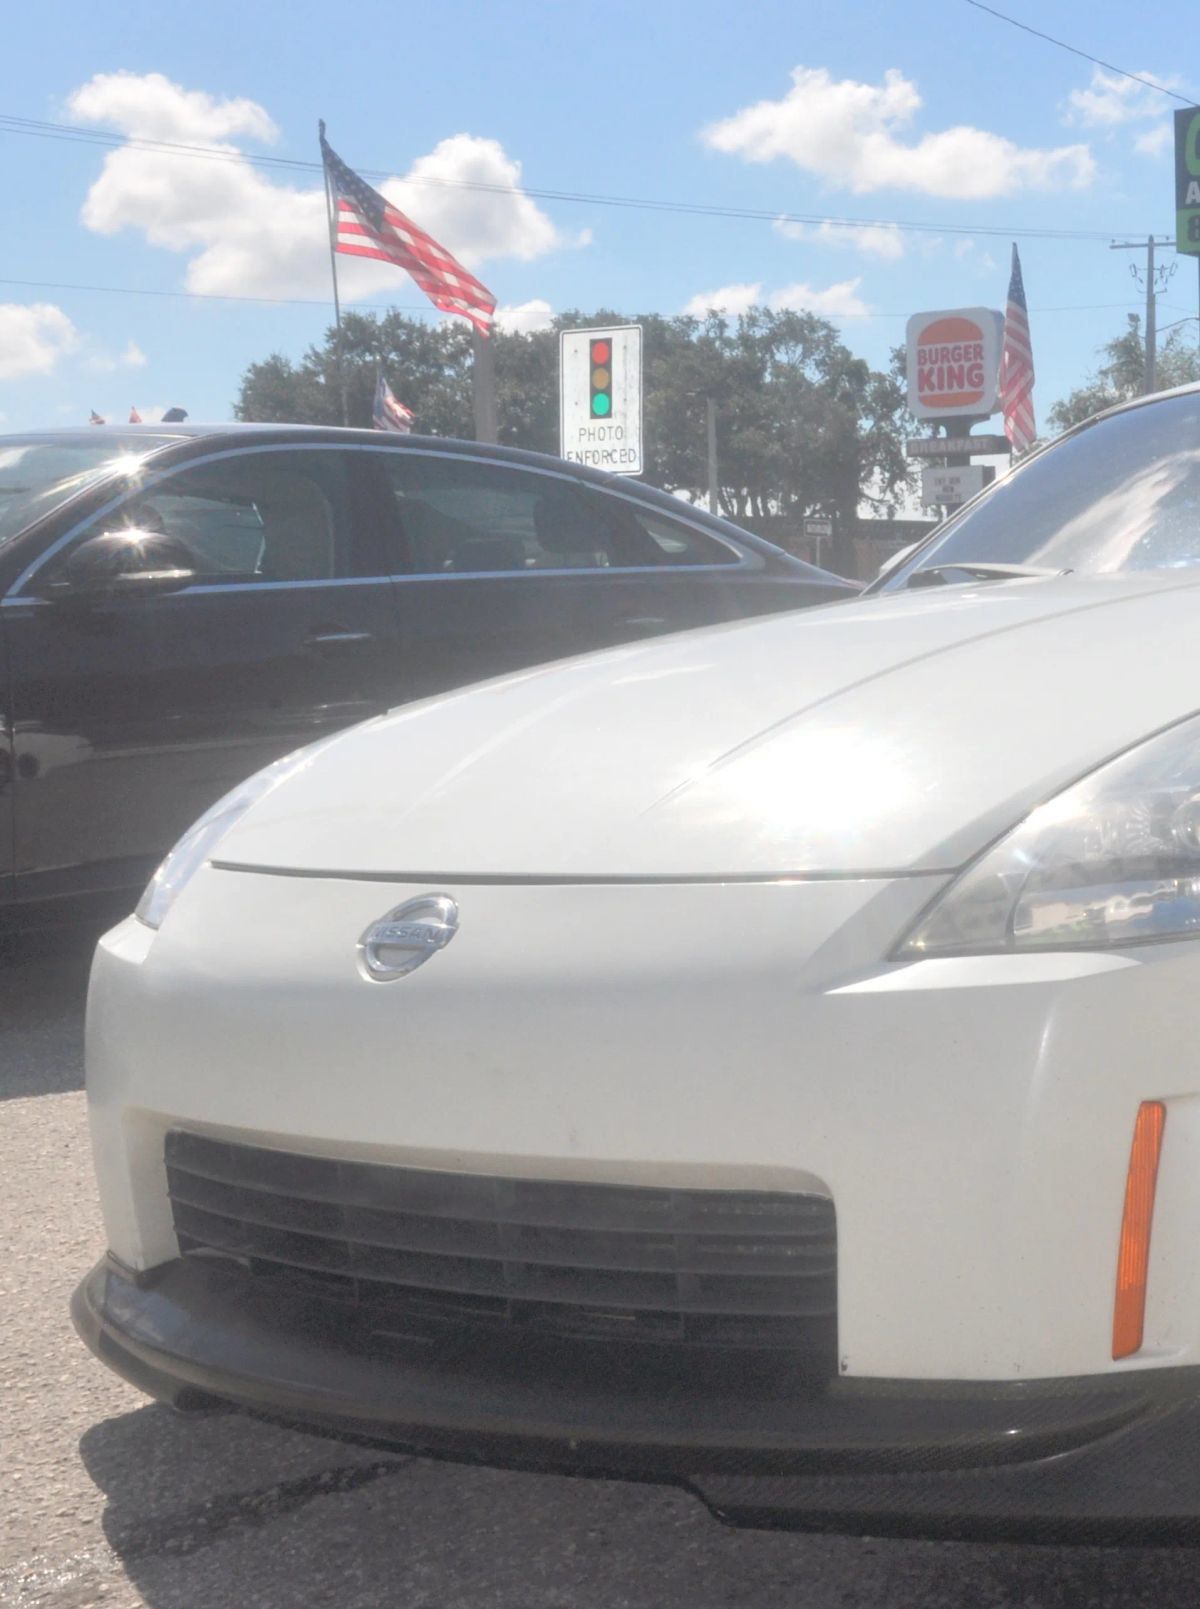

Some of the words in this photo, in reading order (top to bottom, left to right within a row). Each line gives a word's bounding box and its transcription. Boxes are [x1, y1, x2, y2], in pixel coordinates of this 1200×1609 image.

[917, 344, 984, 366] BURGER
[917, 363, 985, 392] KING
[578, 425, 624, 442] PHOTO
[910, 438, 988, 453] BREAKFAST
[566, 449, 637, 465] ENFORCED
